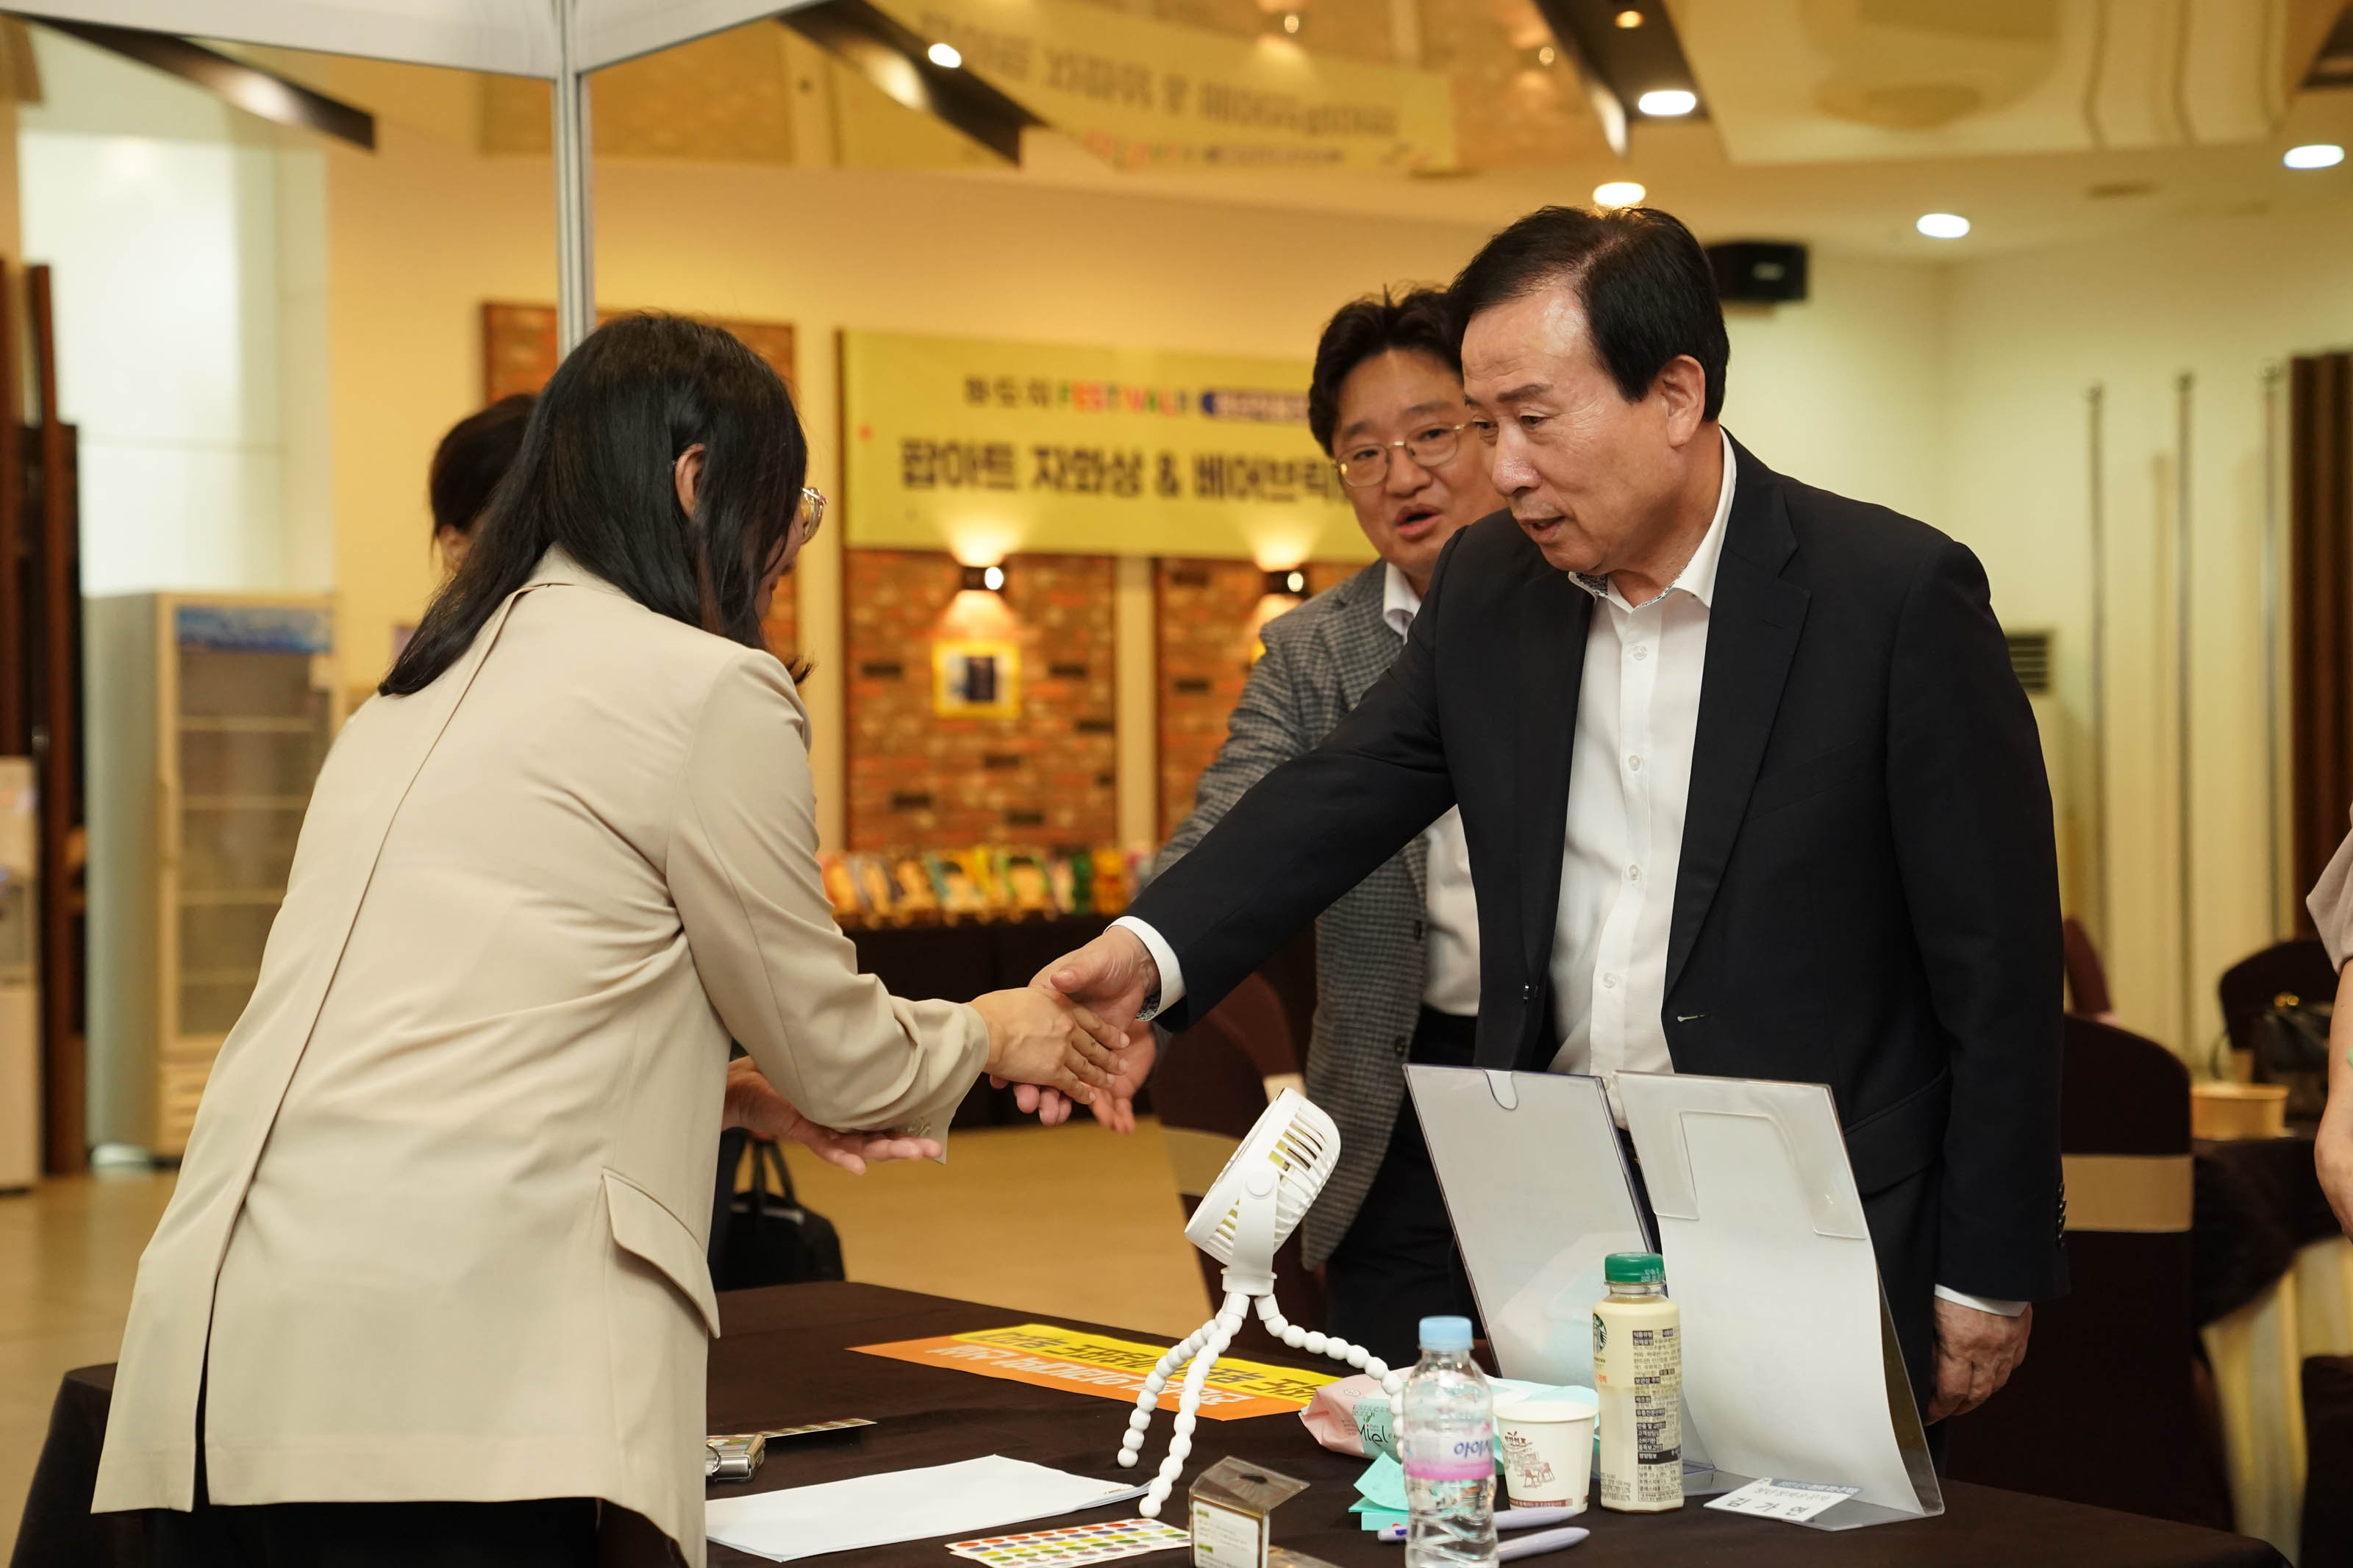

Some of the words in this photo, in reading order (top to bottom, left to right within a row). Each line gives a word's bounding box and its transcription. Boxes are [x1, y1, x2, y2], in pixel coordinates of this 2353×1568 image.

[901, 439, 1016, 490] 팝아트
[1032, 446, 1141, 496] 자화상
[1157, 452, 1179, 497] &
[1240, 1378, 1323, 1400] 작도
